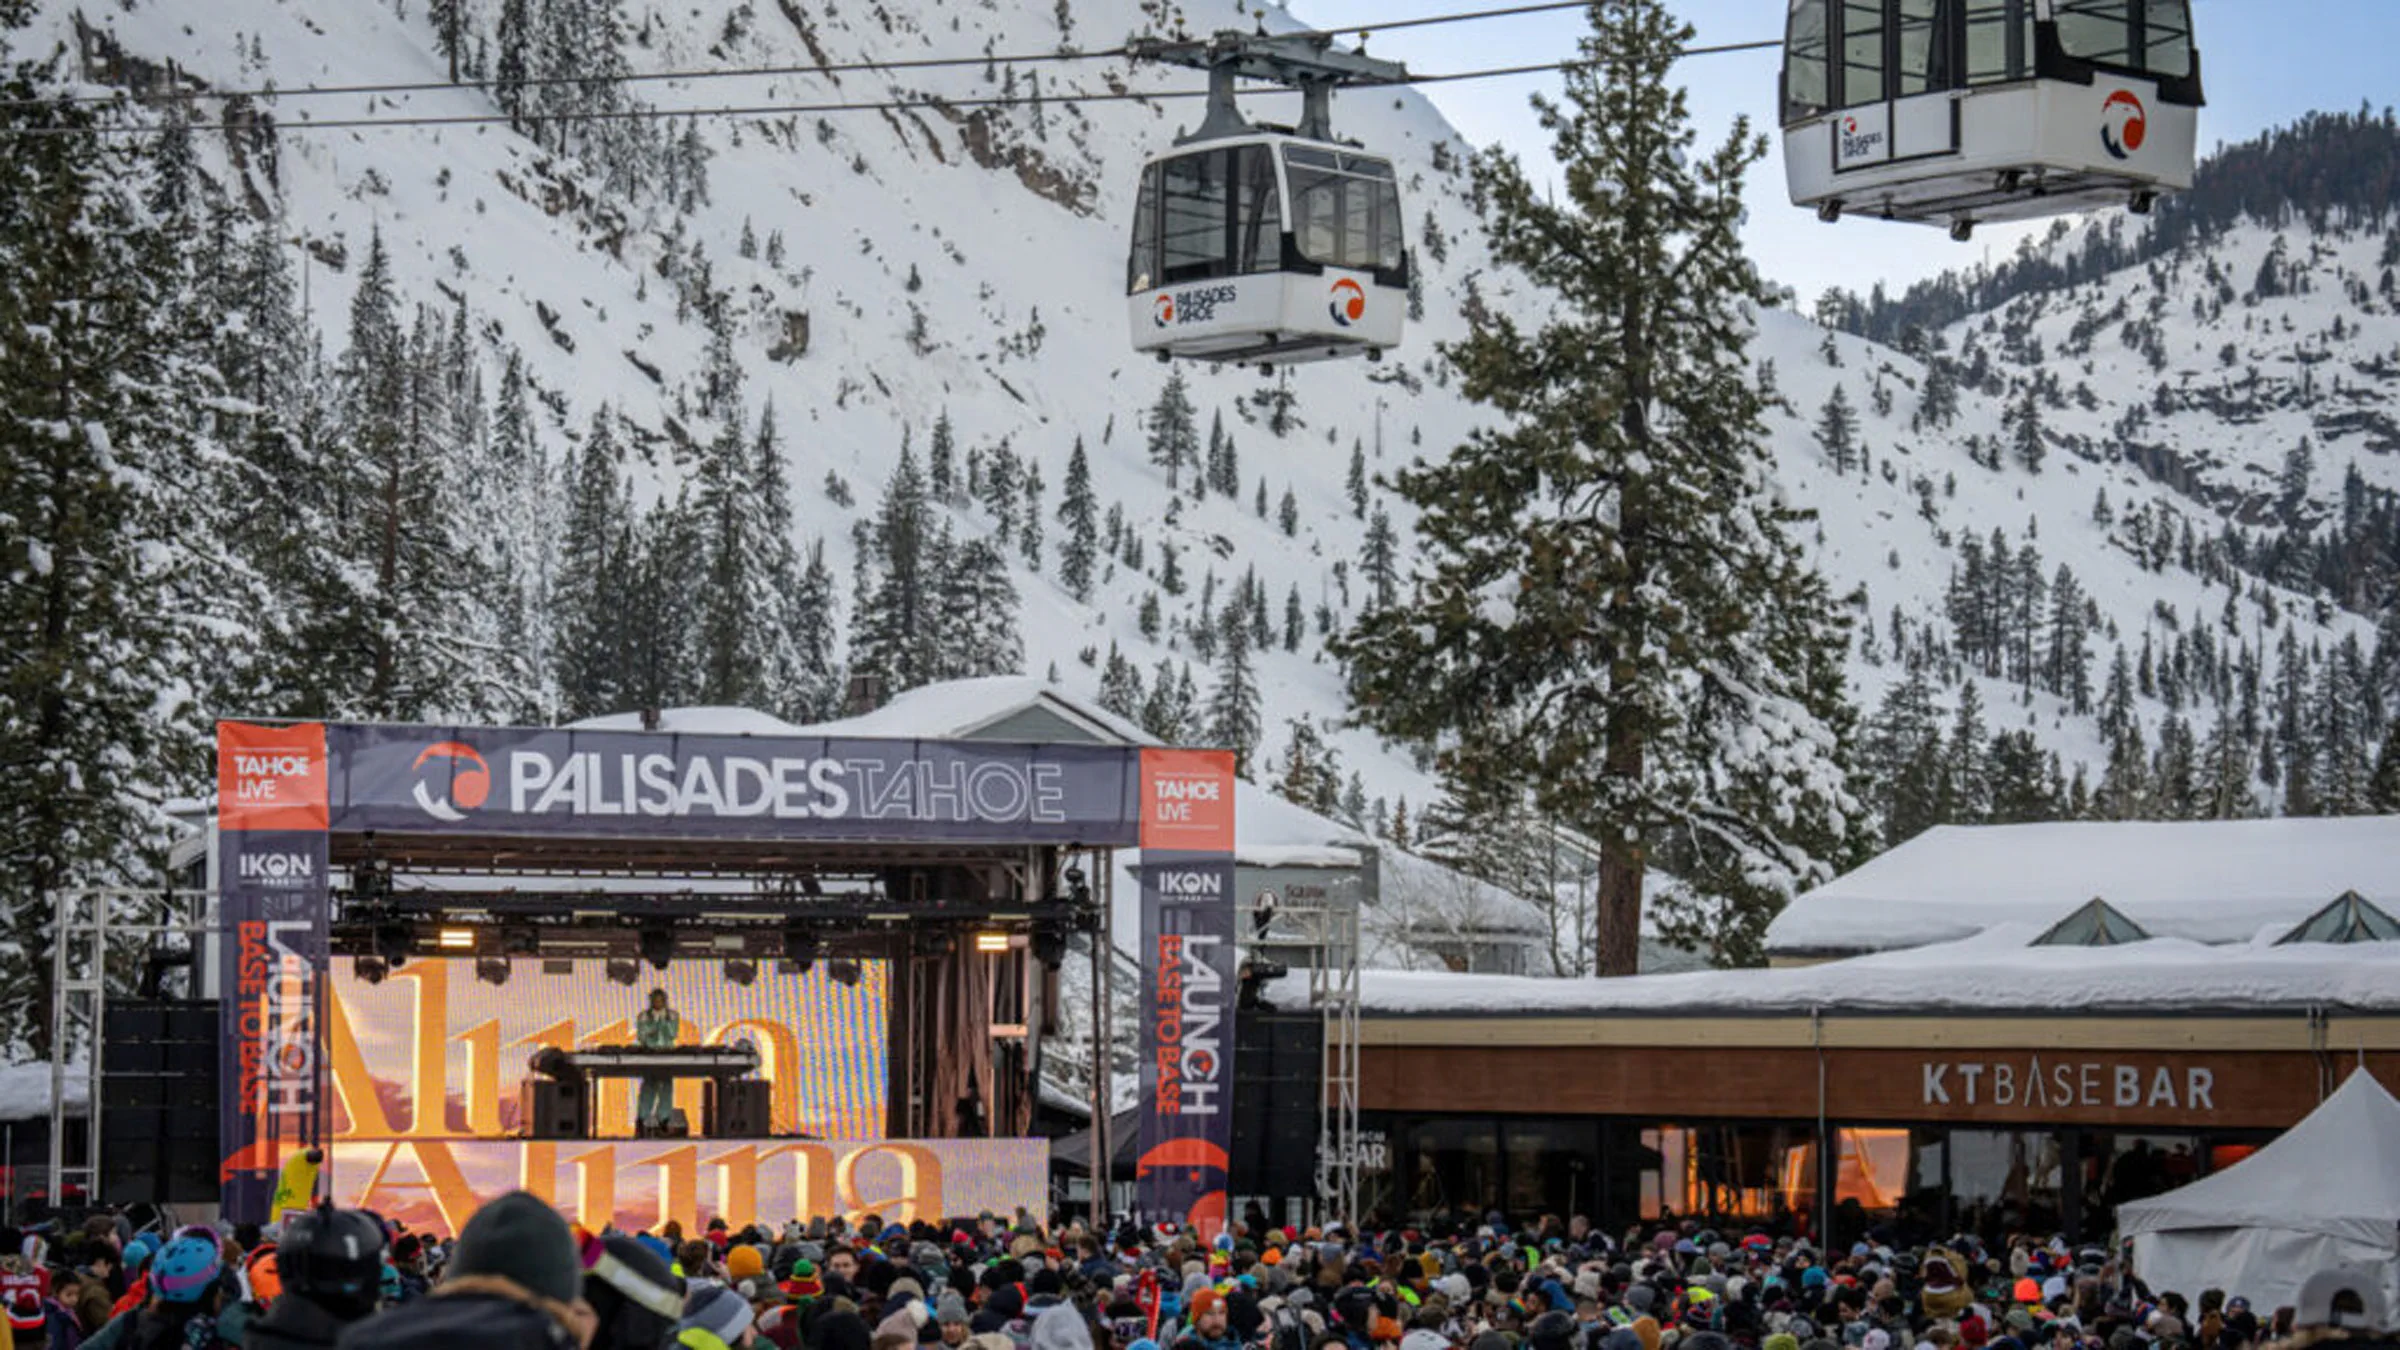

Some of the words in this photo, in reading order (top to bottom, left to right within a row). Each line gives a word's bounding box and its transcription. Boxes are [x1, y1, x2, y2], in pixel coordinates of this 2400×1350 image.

[1176, 285, 1236, 306] PALISADES
[233, 756, 309, 776] TAHOE
[238, 779, 275, 800] LIVE
[510, 751, 850, 819] PALISADES
[844, 758, 1066, 823] TAHOE
[1155, 780, 1219, 800] TAHOE
[1157, 802, 1192, 821] LIVE
[239, 853, 312, 877] IKON
[1159, 872, 1221, 894] IKON
[238, 920, 267, 995] BASE
[1158, 934, 1183, 1003] BASE
[239, 1000, 264, 1038] TO
[268, 920, 314, 1114] LAUNCH
[1157, 1007, 1182, 1043] TO
[1181, 934, 1221, 1114] LAUNCH
[239, 1041, 260, 1115] BASE
[1156, 1046, 1182, 1115] BASE
[1923, 1064, 1984, 1104] KT
[1994, 1055, 2101, 1107] BASE
[2114, 1065, 2214, 1109] BAR
